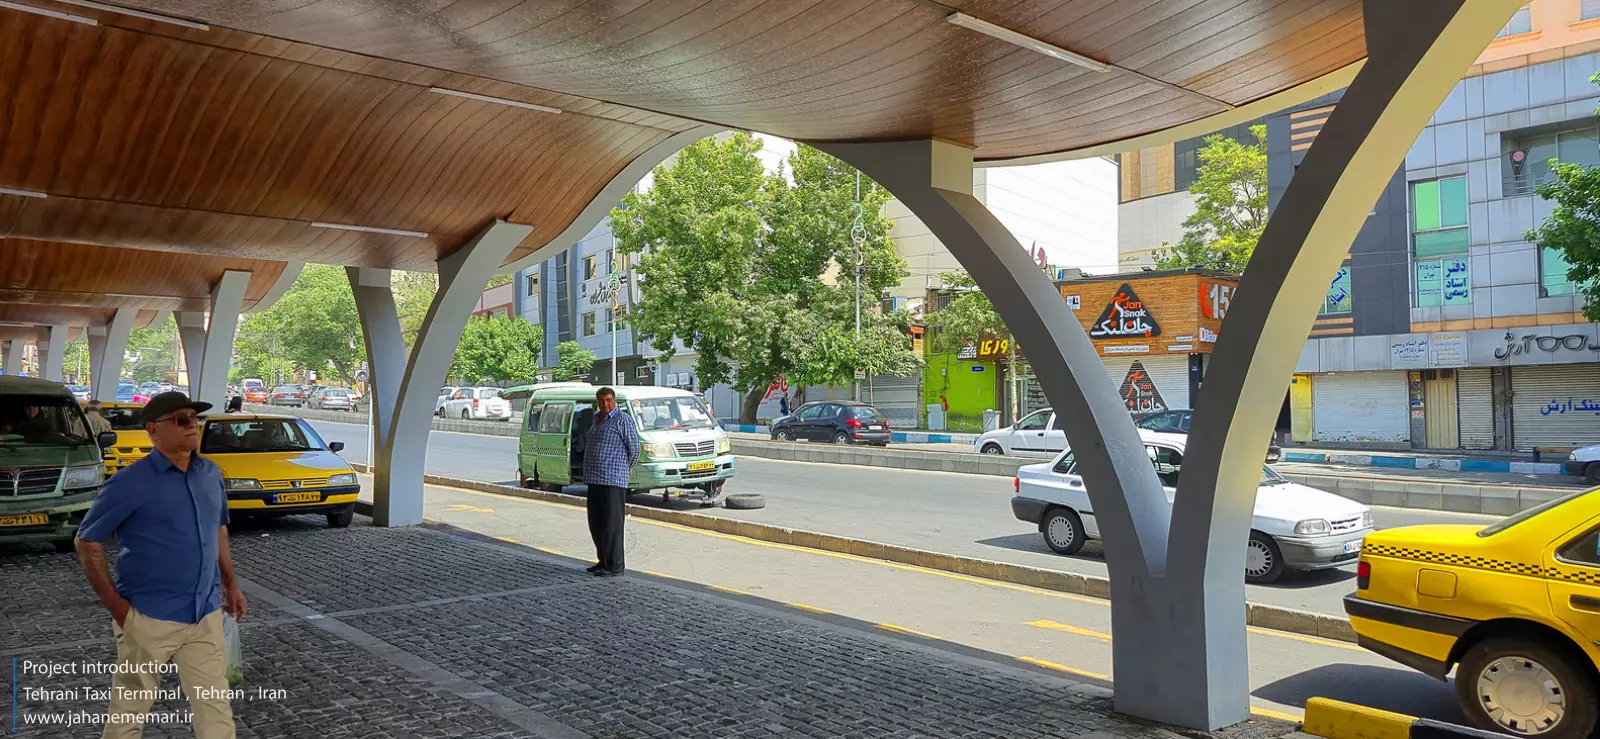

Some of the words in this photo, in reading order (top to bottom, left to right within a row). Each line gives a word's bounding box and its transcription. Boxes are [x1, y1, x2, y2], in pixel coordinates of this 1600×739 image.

[1445, 259, 1466, 277] دفتر
[1445, 277, 1466, 288] اسناد
[1209, 283, 1237, 320] 15
[1444, 288, 1468, 300] رسمی
[1124, 300, 1142, 309] Jan
[1124, 309, 1146, 318] Snak
[1123, 317, 1153, 338] جان
[1494, 331, 1537, 361] آرش
[1540, 397, 1573, 416] آرش
[1574, 399, 1600, 416] ینک
